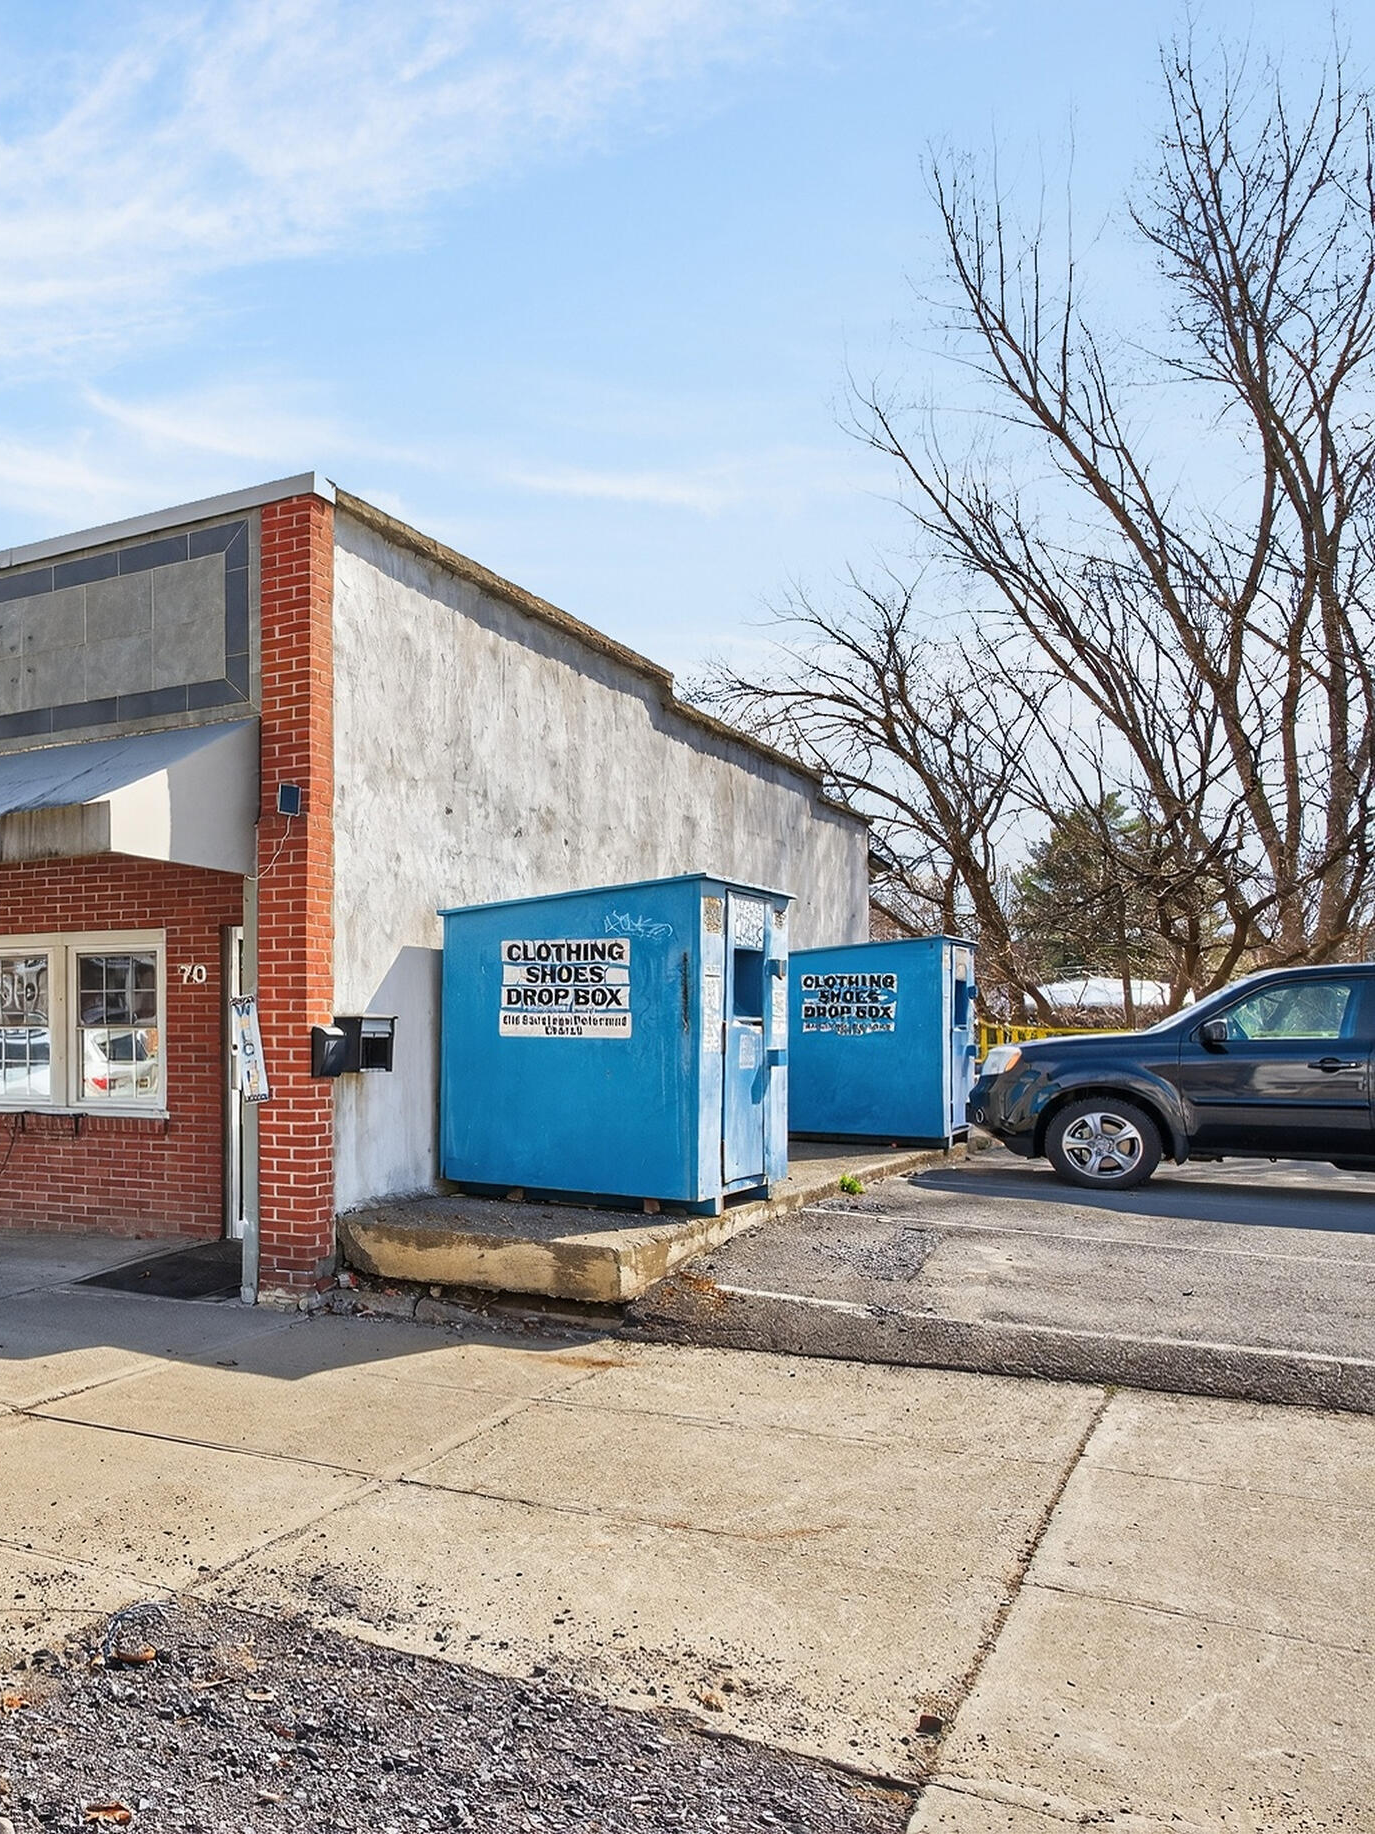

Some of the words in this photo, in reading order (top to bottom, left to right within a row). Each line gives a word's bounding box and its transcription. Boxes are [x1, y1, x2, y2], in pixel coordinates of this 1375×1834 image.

[507, 943, 625, 962] CLOTHING
[177, 963, 207, 984] 70
[525, 965, 605, 983] SHOES
[506, 988, 569, 1006] DROP
[574, 988, 623, 1006] BOX
